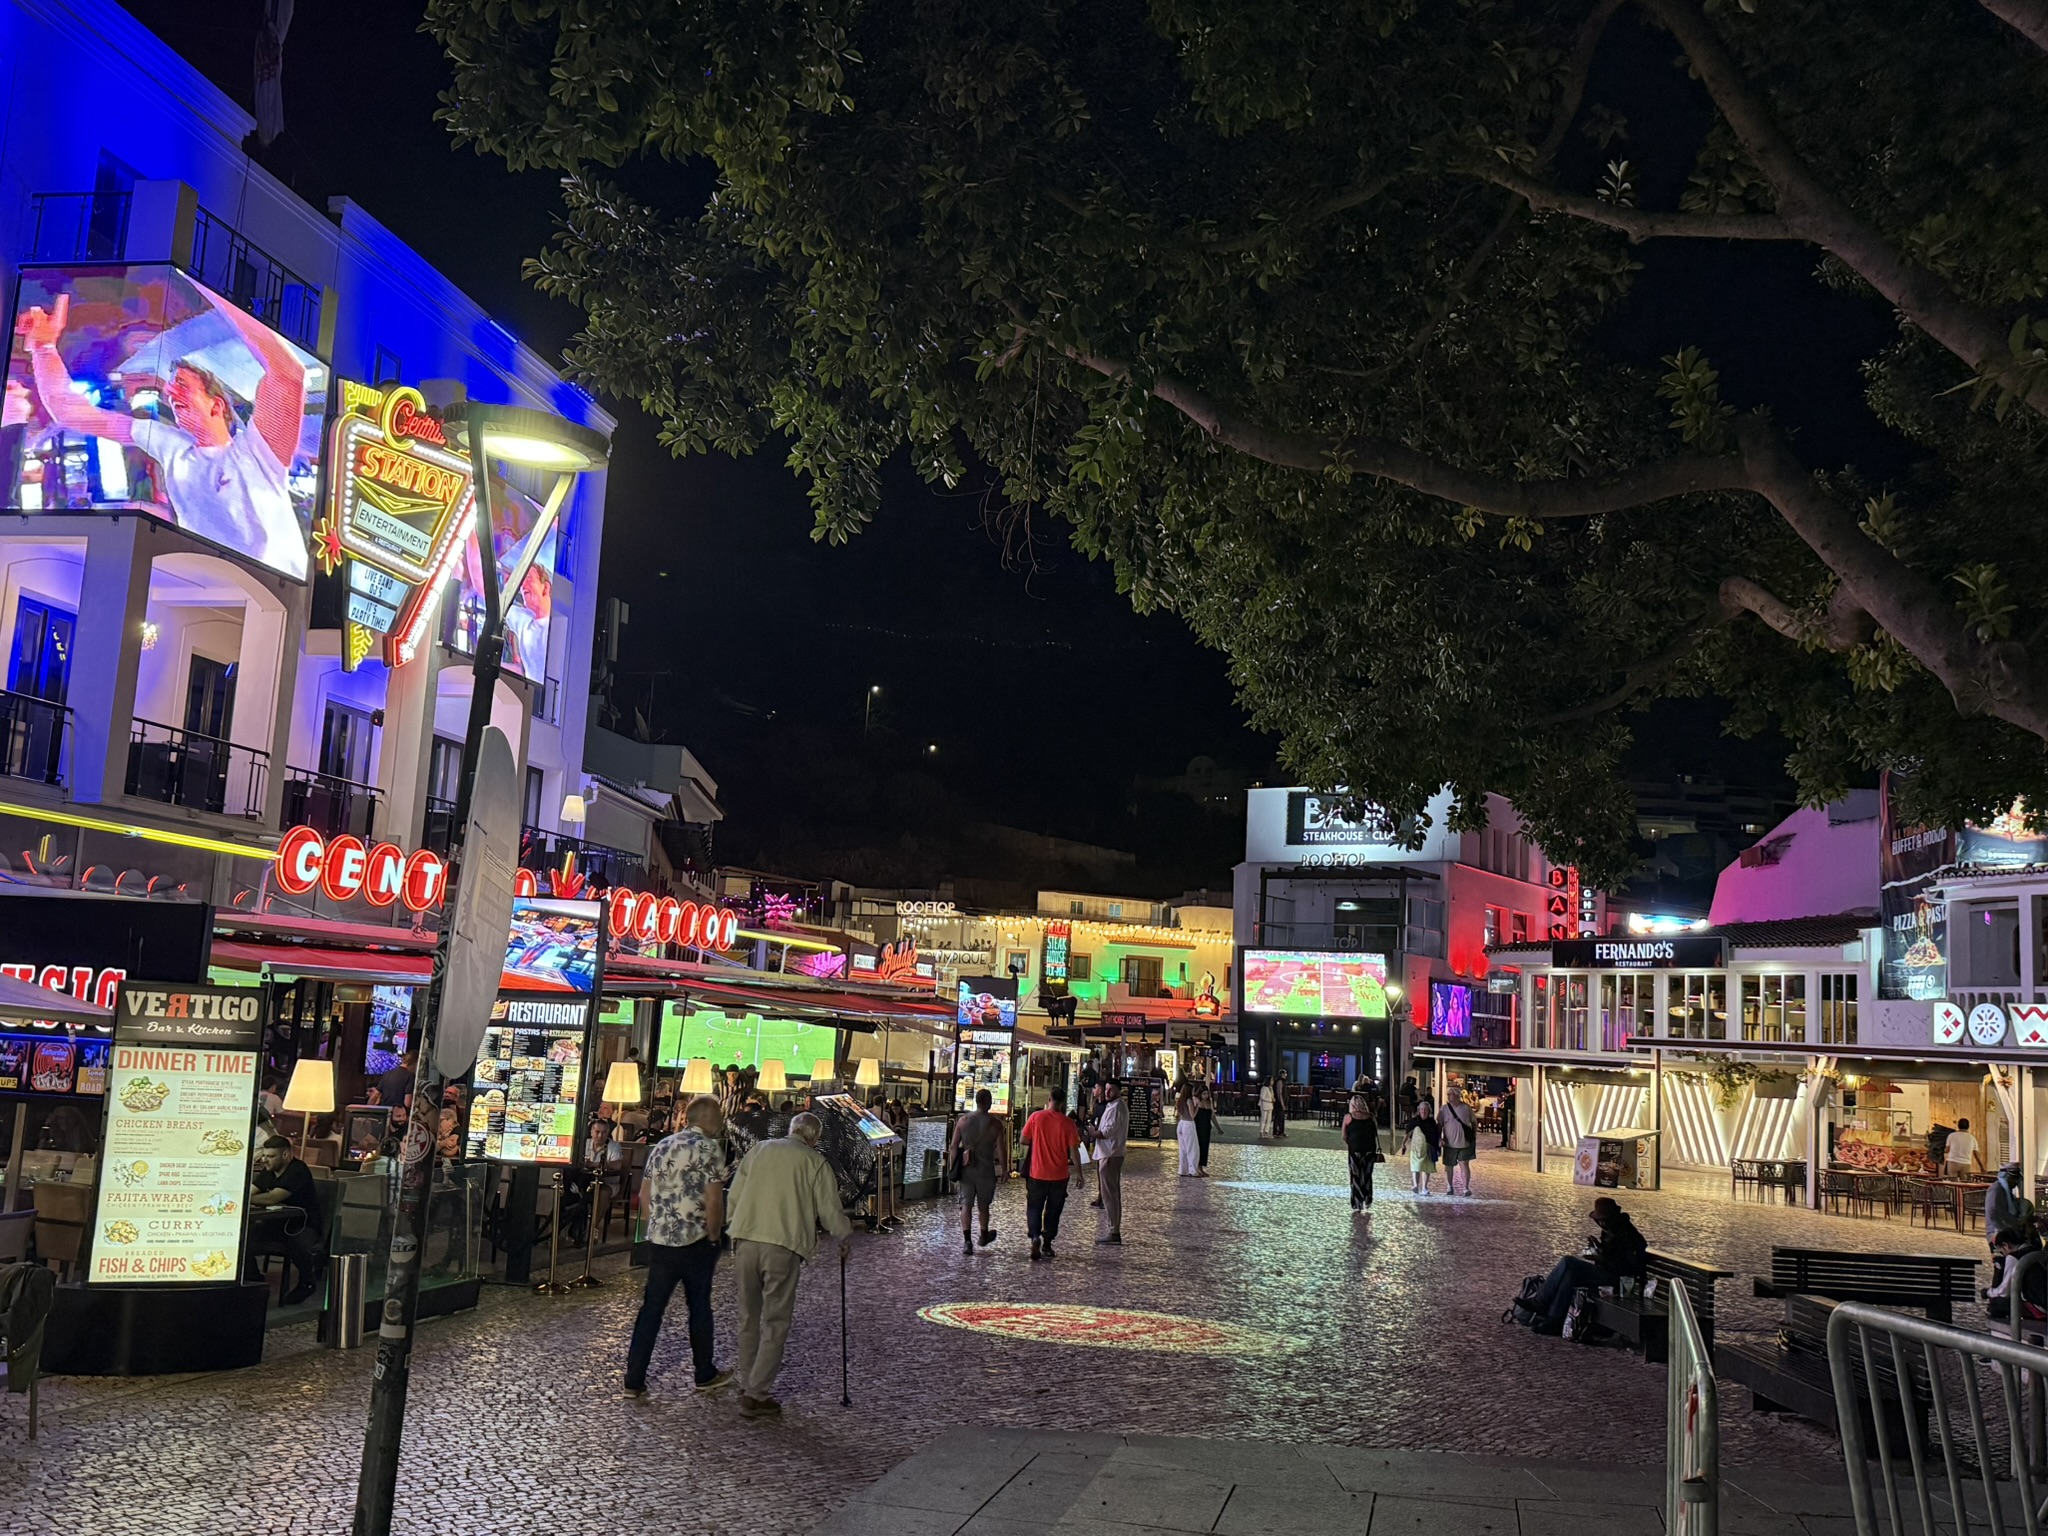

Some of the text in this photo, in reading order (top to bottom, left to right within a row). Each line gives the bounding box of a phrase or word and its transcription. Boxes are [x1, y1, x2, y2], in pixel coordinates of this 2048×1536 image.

[359, 446, 463, 503] STATION
[359, 508, 429, 551] ENTERTAINMENT
[364, 568, 394, 590] LIVE BAND
[365, 602, 378, 615] IT'S
[350, 606, 387, 630] PARTY TIME!
[1302, 831, 1364, 842] STEAKHOUSE
[1892, 835, 1915, 856] BUFFET
[1915, 834, 1922, 848] &
[1301, 853, 1366, 867] ROOFTOP
[896, 901, 956, 914] ROOFTOP
[603, 888, 738, 946] TATION
[1893, 912, 1917, 932] PIZZA
[1047, 936, 1067, 950] STEAK
[1595, 940, 1674, 961] FERNANDO'S
[1046, 950, 1067, 964] HOUSE
[508, 1001, 587, 1025] RESTAURANT
[147, 1021, 232, 1036] Bar & Kitchen
[514, 1028, 541, 1036] PASTAS
[973, 1031, 1012, 1044] RESTAURANT
[118, 1050, 254, 1074] DINNER TIME
[115, 1119, 205, 1130] CHICKEN BREAST
[107, 1193, 194, 1203] FAJITA WRAPS
[148, 1220, 204, 1230] CURRY
[99, 1257, 187, 1273] FISH & CHIPS
